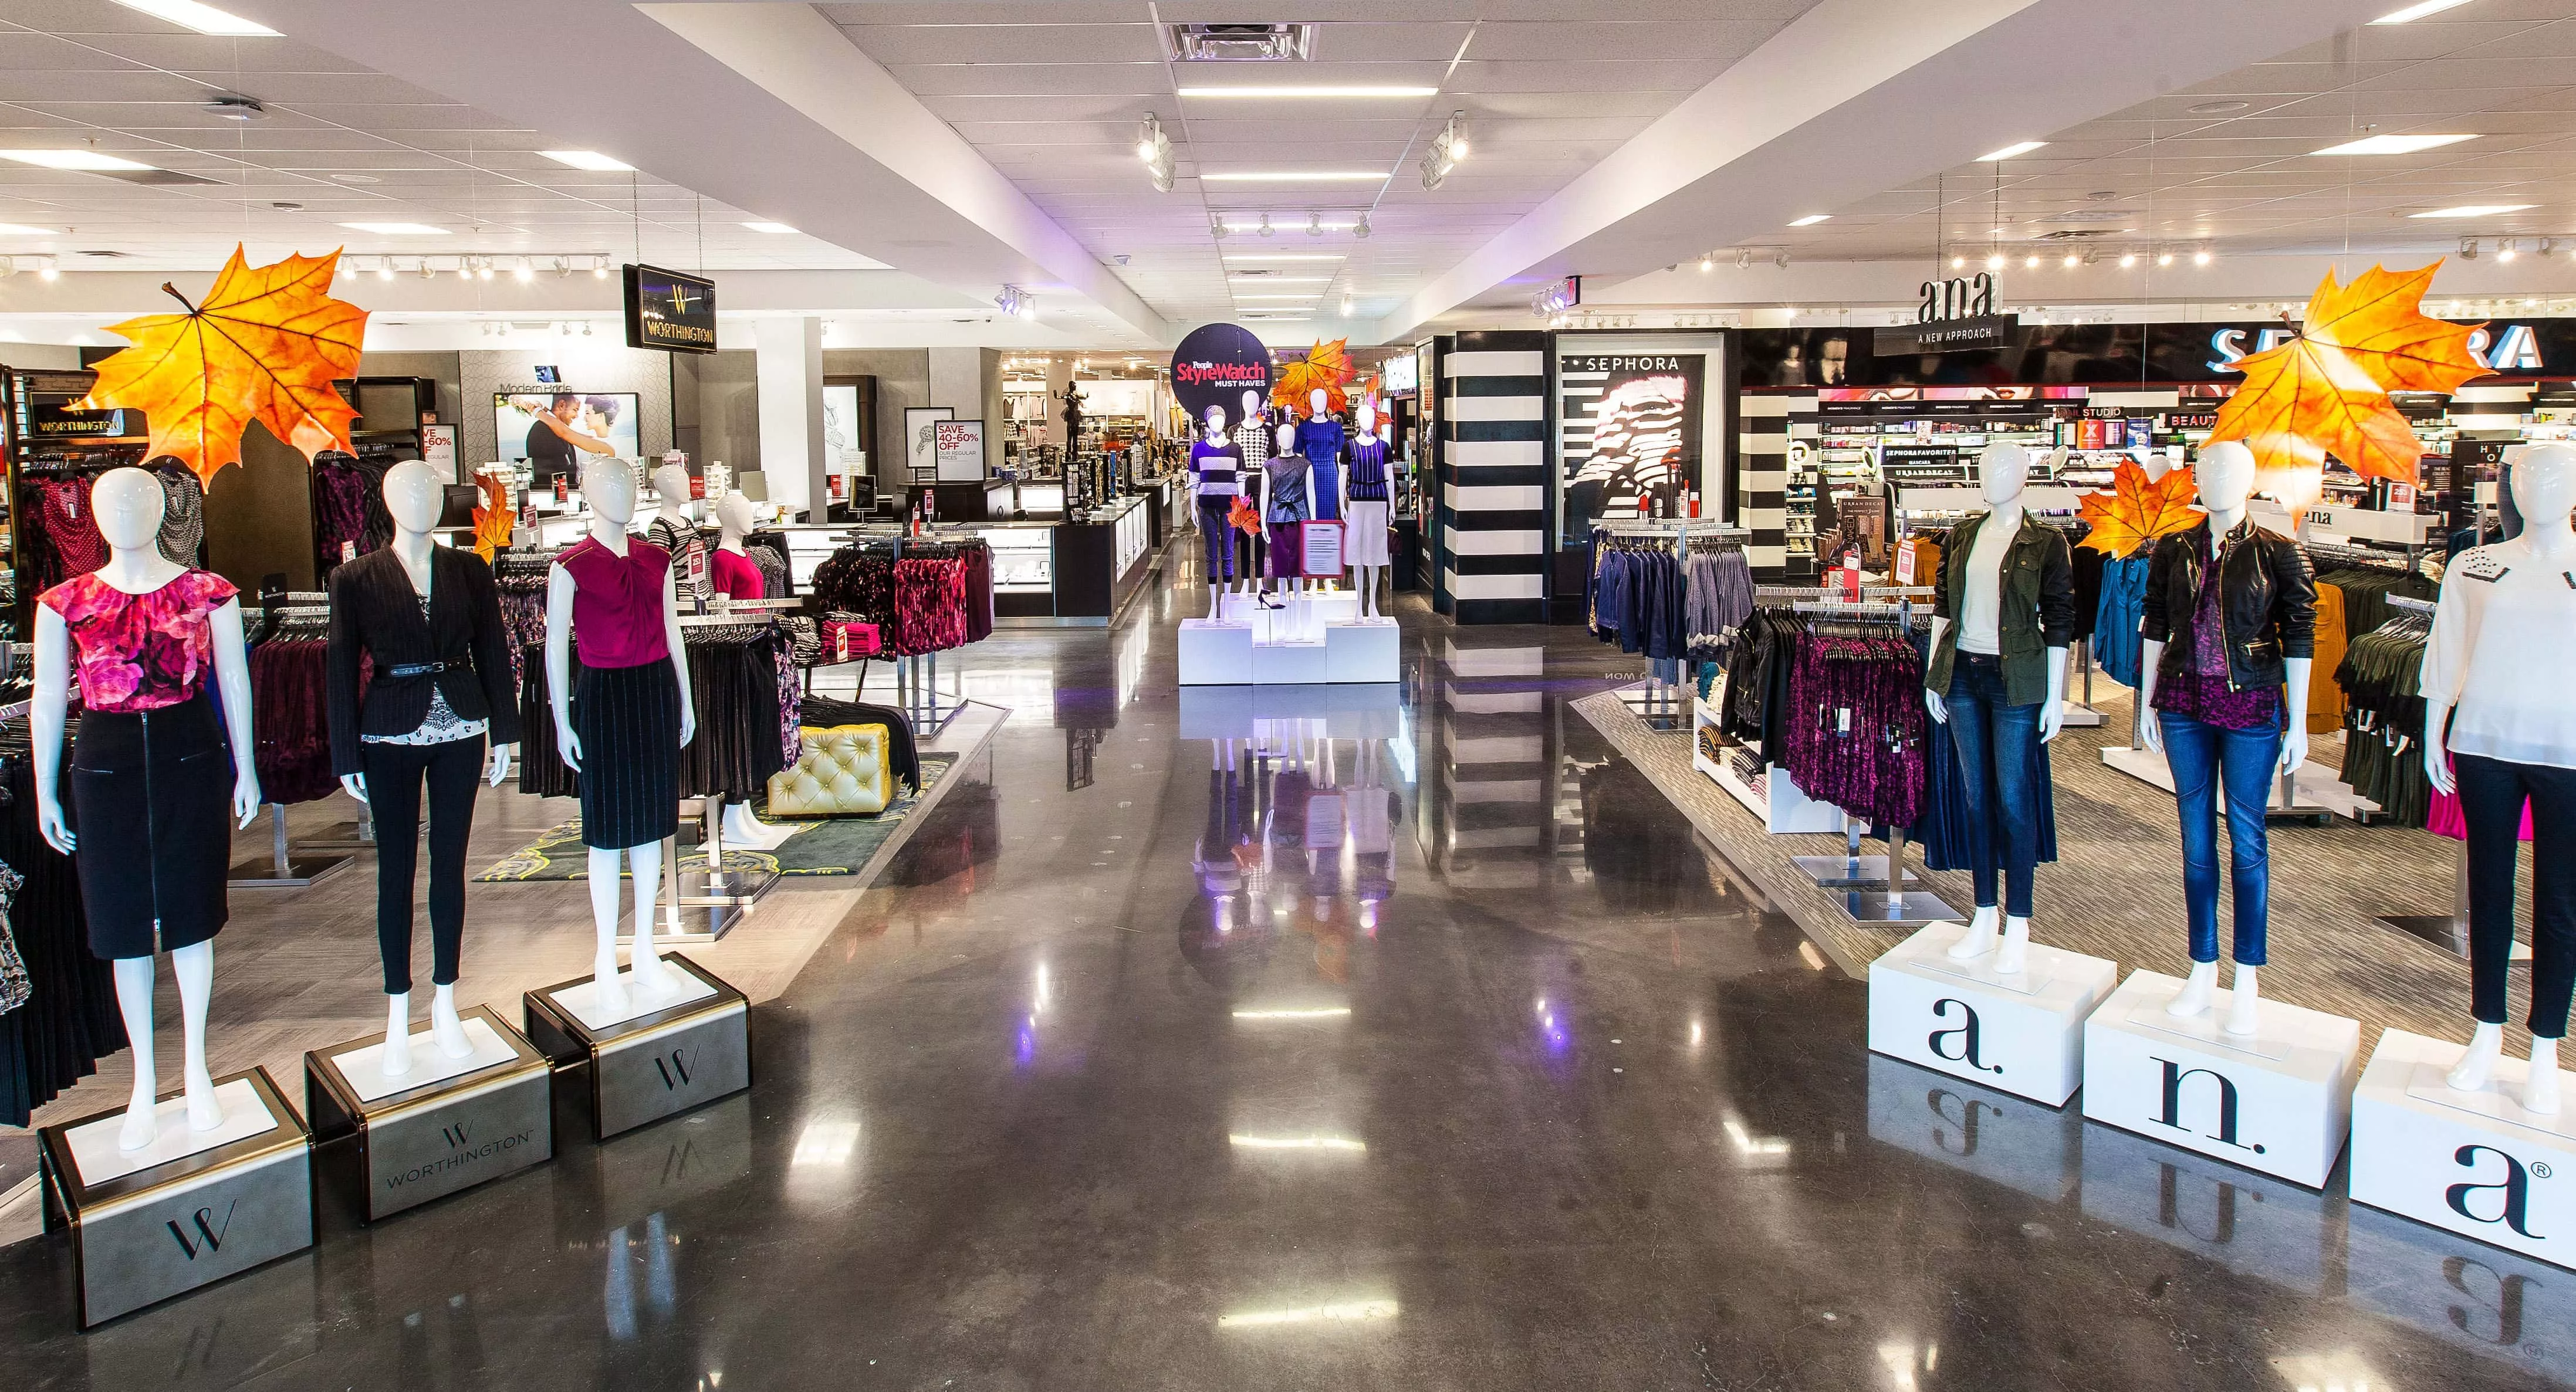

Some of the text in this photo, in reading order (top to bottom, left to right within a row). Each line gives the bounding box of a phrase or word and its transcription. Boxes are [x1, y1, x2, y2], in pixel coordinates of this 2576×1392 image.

[1918, 272, 1993, 323] ana
[647, 320, 713, 343] WORTHINGTON
[1918, 327, 1992, 343] A NEW APPROACH
[1587, 357, 1679, 371] SEPHORA
[1177, 361, 1265, 385] StyleWatch
[500, 382, 573, 393] Modern Bride
[2083, 408, 2121, 417] STUDIO
[39, 421, 119, 431] WORTHINGTON
[2172, 415, 2217, 426] BEAUT
[423, 429, 436, 437] VE
[939, 425, 965, 433] SAVE
[424, 437, 451, 446] -60%
[939, 433, 979, 442] 40-60%
[2302, 511, 2332, 525] na
[1928, 998, 2003, 1074] a.
[655, 1044, 700, 1092] W
[2148, 1056, 2266, 1154] n.
[443, 1119, 474, 1149] W
[166, 1198, 240, 1261] W
